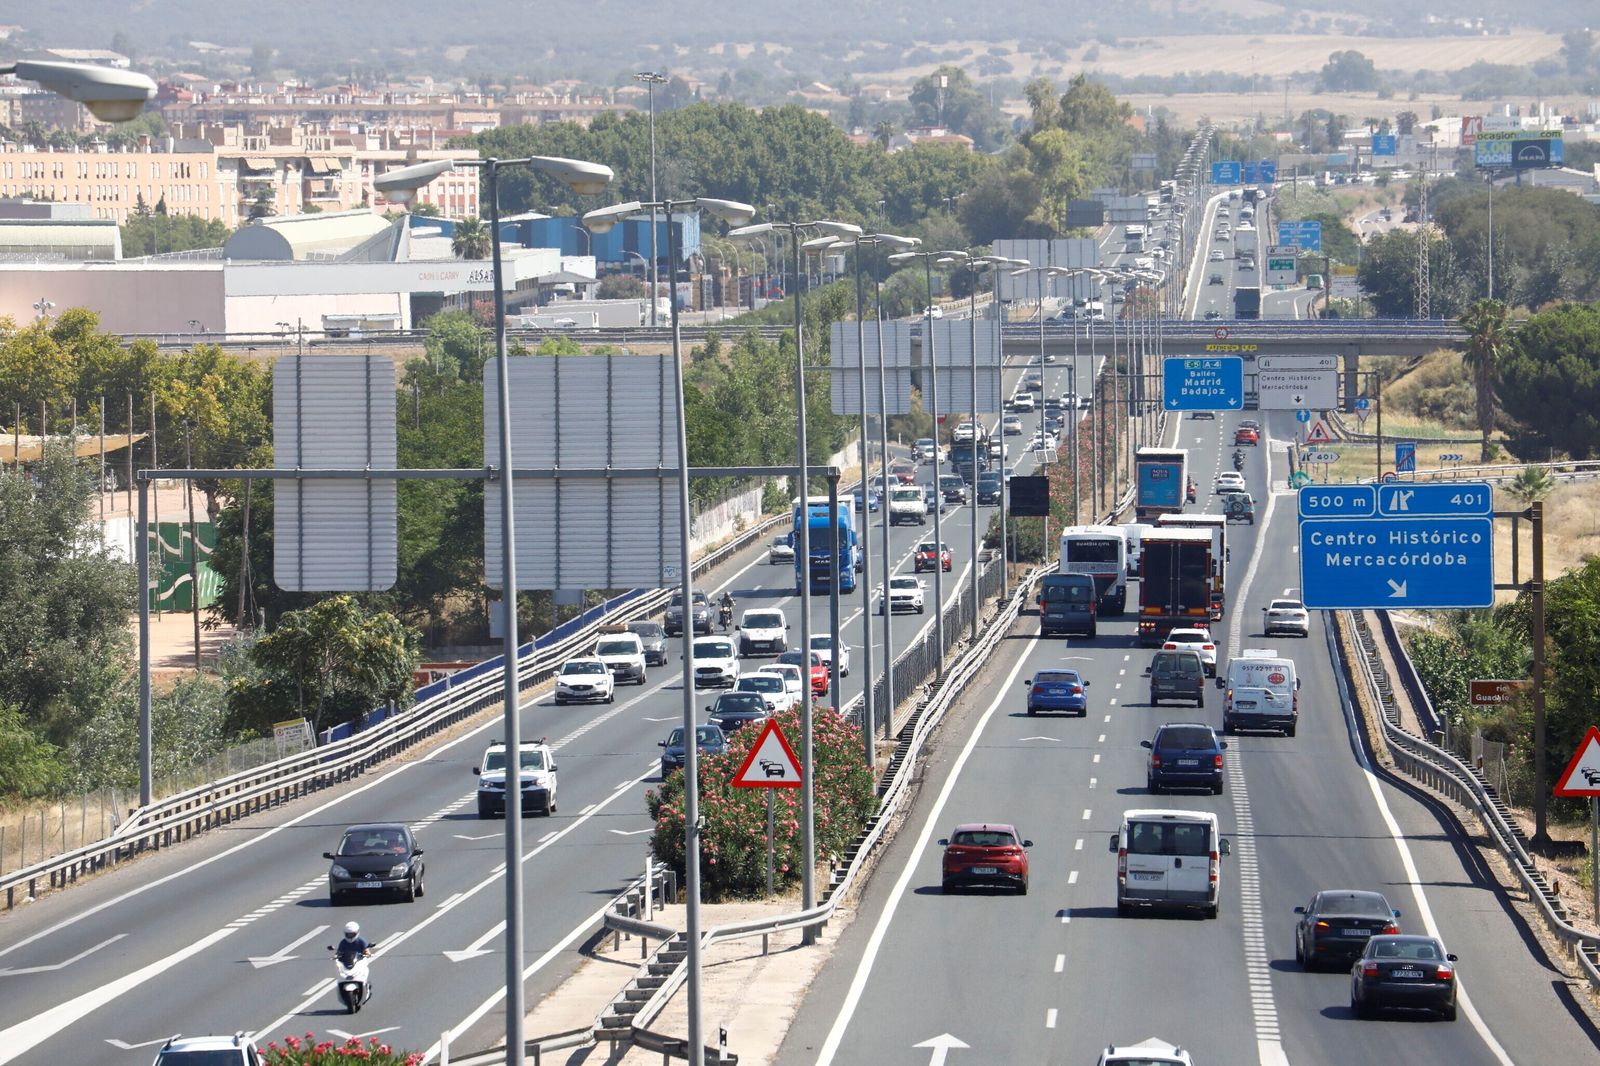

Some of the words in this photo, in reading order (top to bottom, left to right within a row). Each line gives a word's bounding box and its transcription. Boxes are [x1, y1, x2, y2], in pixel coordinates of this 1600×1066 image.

[1185, 378, 1221, 386] Madrid
[1181, 388, 1225, 396] Badajoz
[1309, 496, 1344, 508] 500
[1353, 497, 1366, 507] m
[1450, 493, 1483, 505] 401
[1310, 532, 1376, 546] Centro
[1389, 530, 1482, 545] Histórico
[1326, 552, 1467, 567] Mercacórdoba
